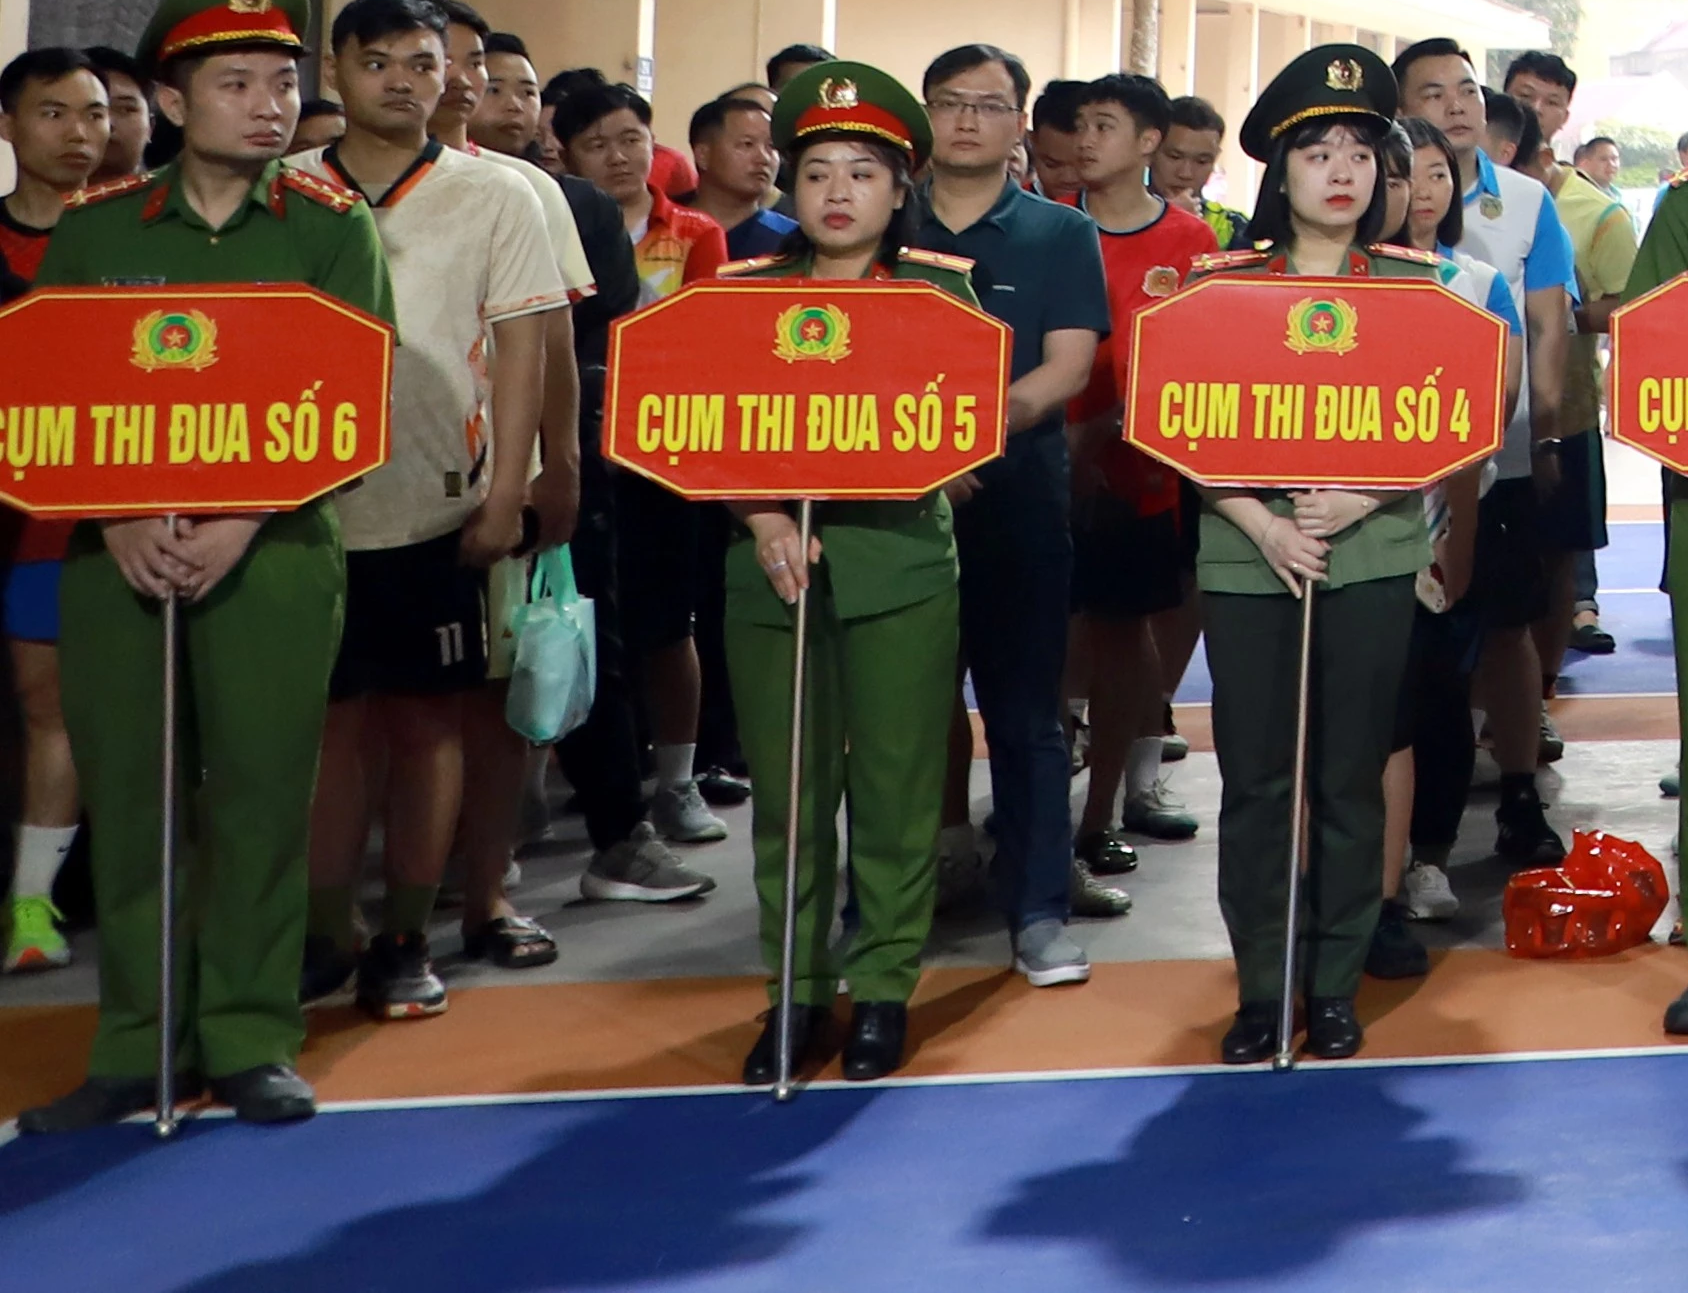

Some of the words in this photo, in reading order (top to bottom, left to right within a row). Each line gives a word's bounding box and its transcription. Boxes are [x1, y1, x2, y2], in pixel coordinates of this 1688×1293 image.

[0, 404, 76, 481] ỤM
[90, 404, 156, 466] THI
[169, 403, 250, 464] ĐUA
[264, 381, 323, 463] SỐ
[332, 402, 358, 463] 6
[636, 394, 725, 465] CỤM
[736, 394, 796, 452] THI
[806, 394, 881, 452] ĐUA
[892, 373, 945, 452] SỐ
[953, 395, 977, 453] 5
[1159, 382, 1241, 451] CỤM
[1251, 384, 1305, 440] THI
[1314, 385, 1383, 442] ĐUA
[1393, 367, 1443, 443] SỐ
[1449, 389, 1471, 443] 4
[434, 621, 464, 666] 11
